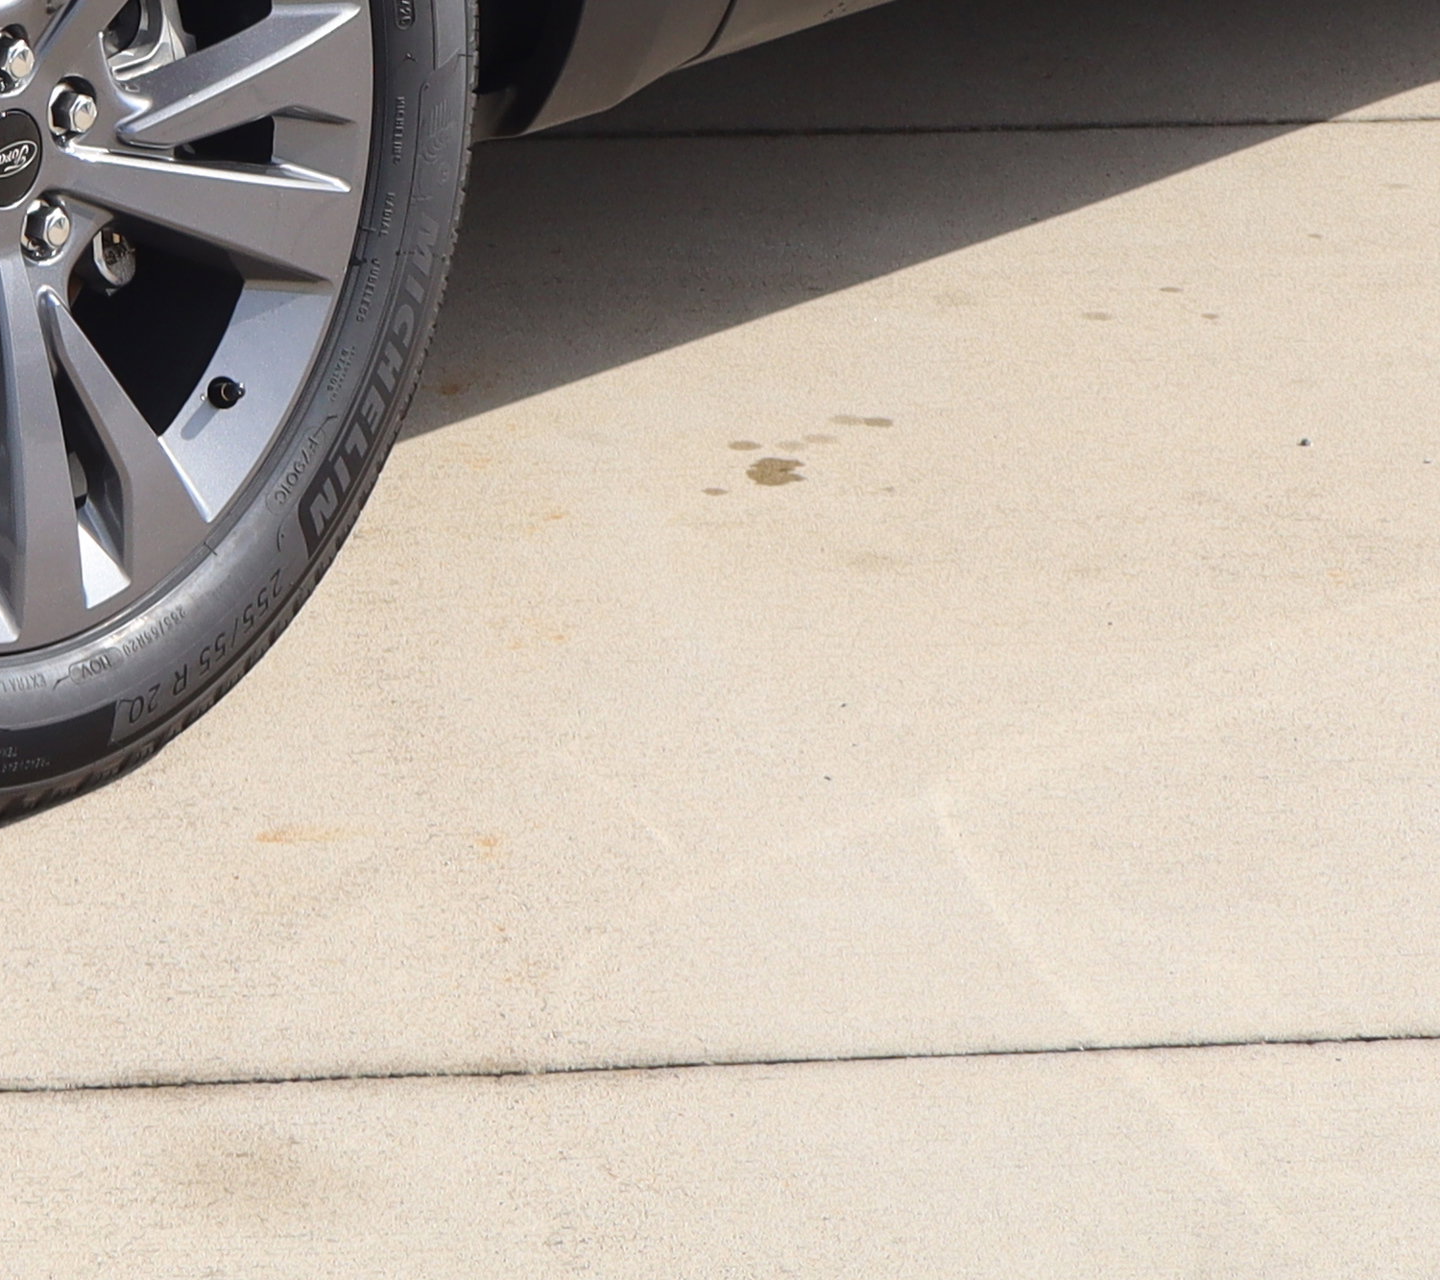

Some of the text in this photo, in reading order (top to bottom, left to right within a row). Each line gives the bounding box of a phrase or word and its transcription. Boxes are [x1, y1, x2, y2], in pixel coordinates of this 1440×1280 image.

[308, 211, 440, 536] MICHELIN
[198, 566, 284, 678] 255/55
[167, 662, 192, 698] R
